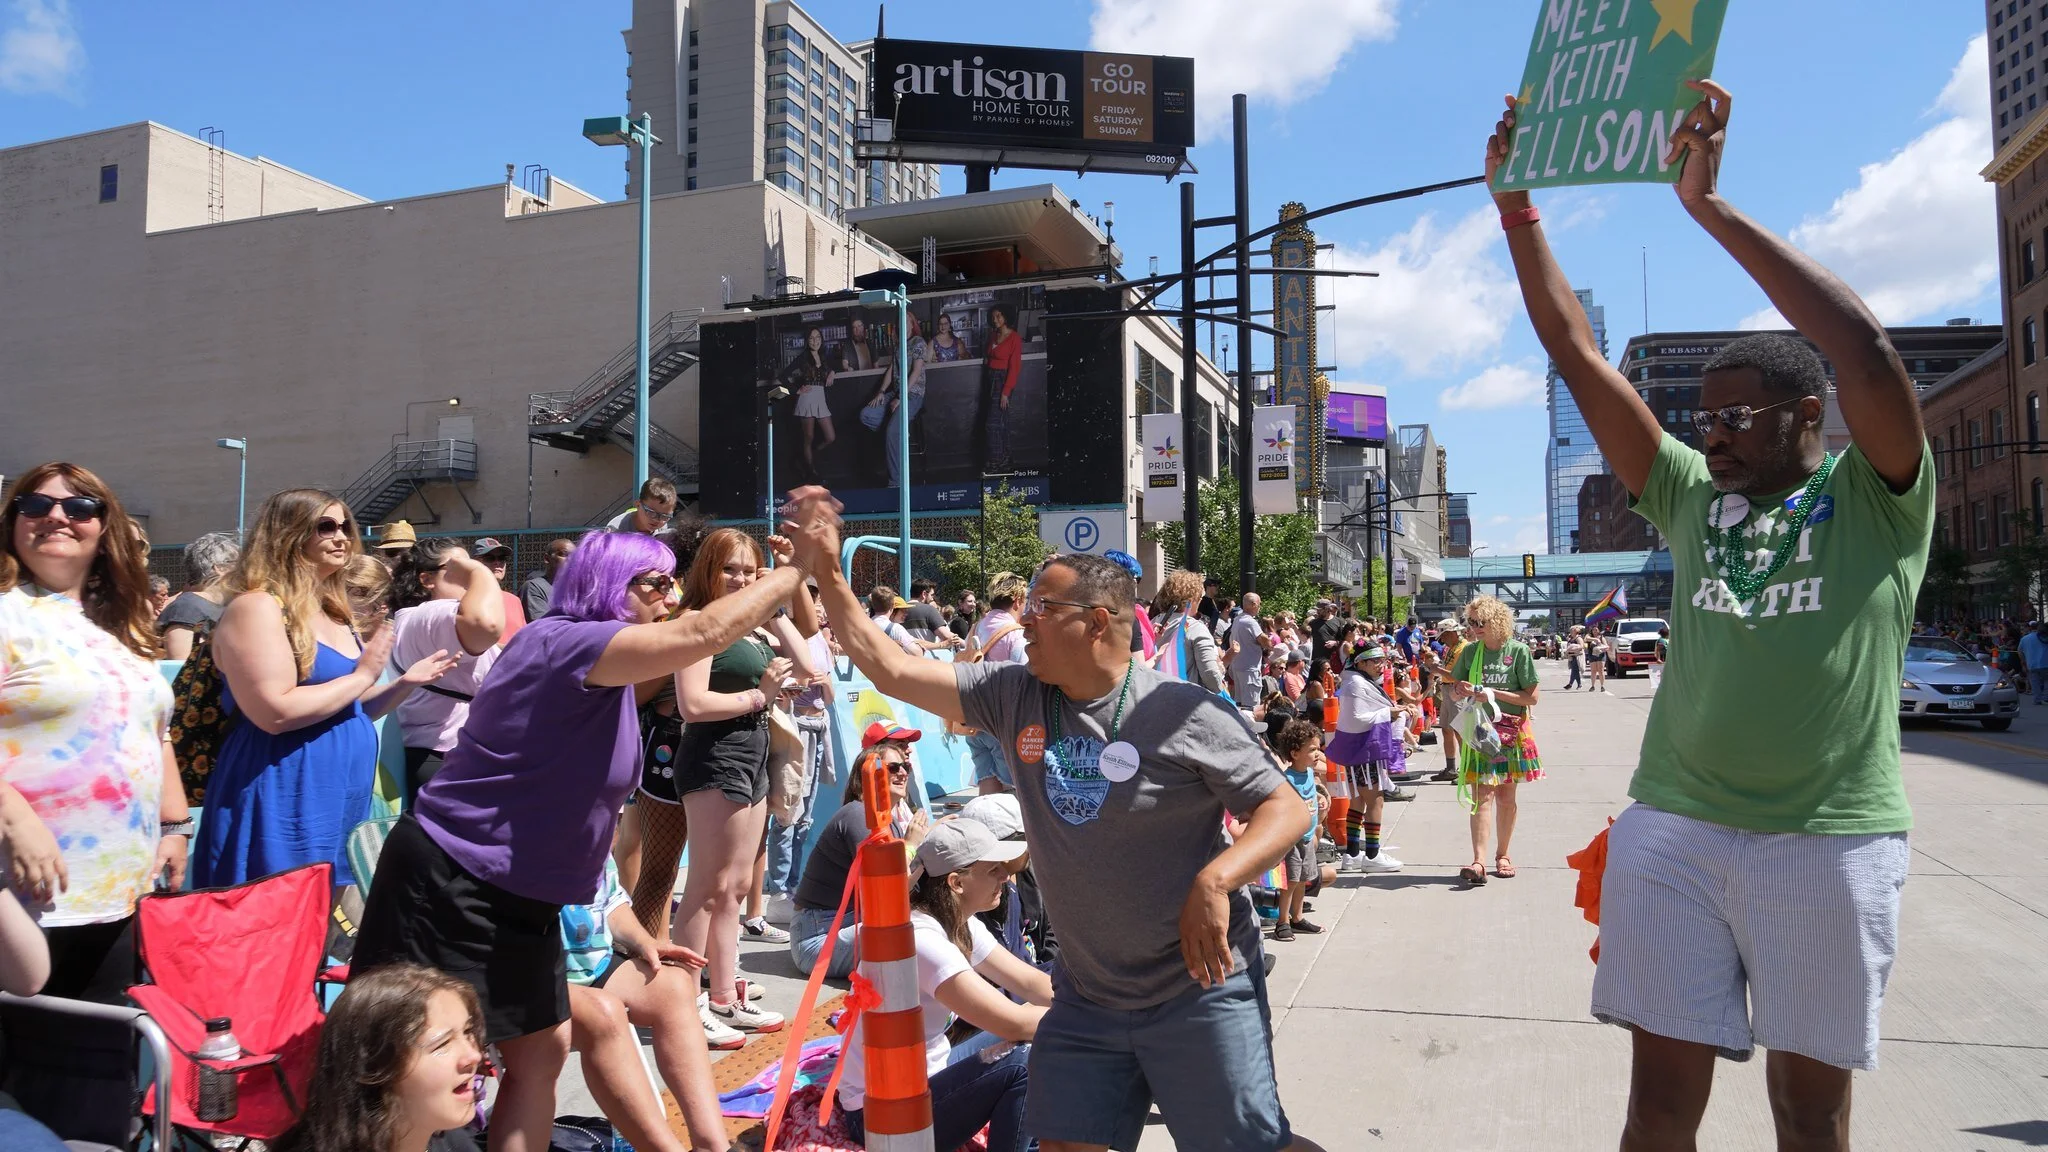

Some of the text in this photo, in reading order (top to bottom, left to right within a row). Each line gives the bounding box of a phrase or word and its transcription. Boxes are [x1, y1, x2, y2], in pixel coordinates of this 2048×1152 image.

[1536, 0, 1631, 53] MEET
[1103, 62, 1133, 78] GO
[1536, 36, 1638, 114] KEITH
[893, 55, 1070, 103] artisan
[1090, 77, 1147, 96] TOUR
[973, 100, 1070, 118] HOME TOUR
[1101, 105, 1136, 115] FRIDAY
[987, 115, 1020, 124] PARADE
[1093, 115, 1144, 126] SATURDAY
[1099, 126, 1138, 136] SUNDAY
[1503, 108, 1686, 184] ELLISON
[1145, 154, 1176, 164] 092010
[1660, 346, 1710, 354] EMBASSY
[1258, 453, 1288, 462] PRIDE
[1148, 461, 1177, 470] PRIDE
[1074, 523, 1092, 546] P
